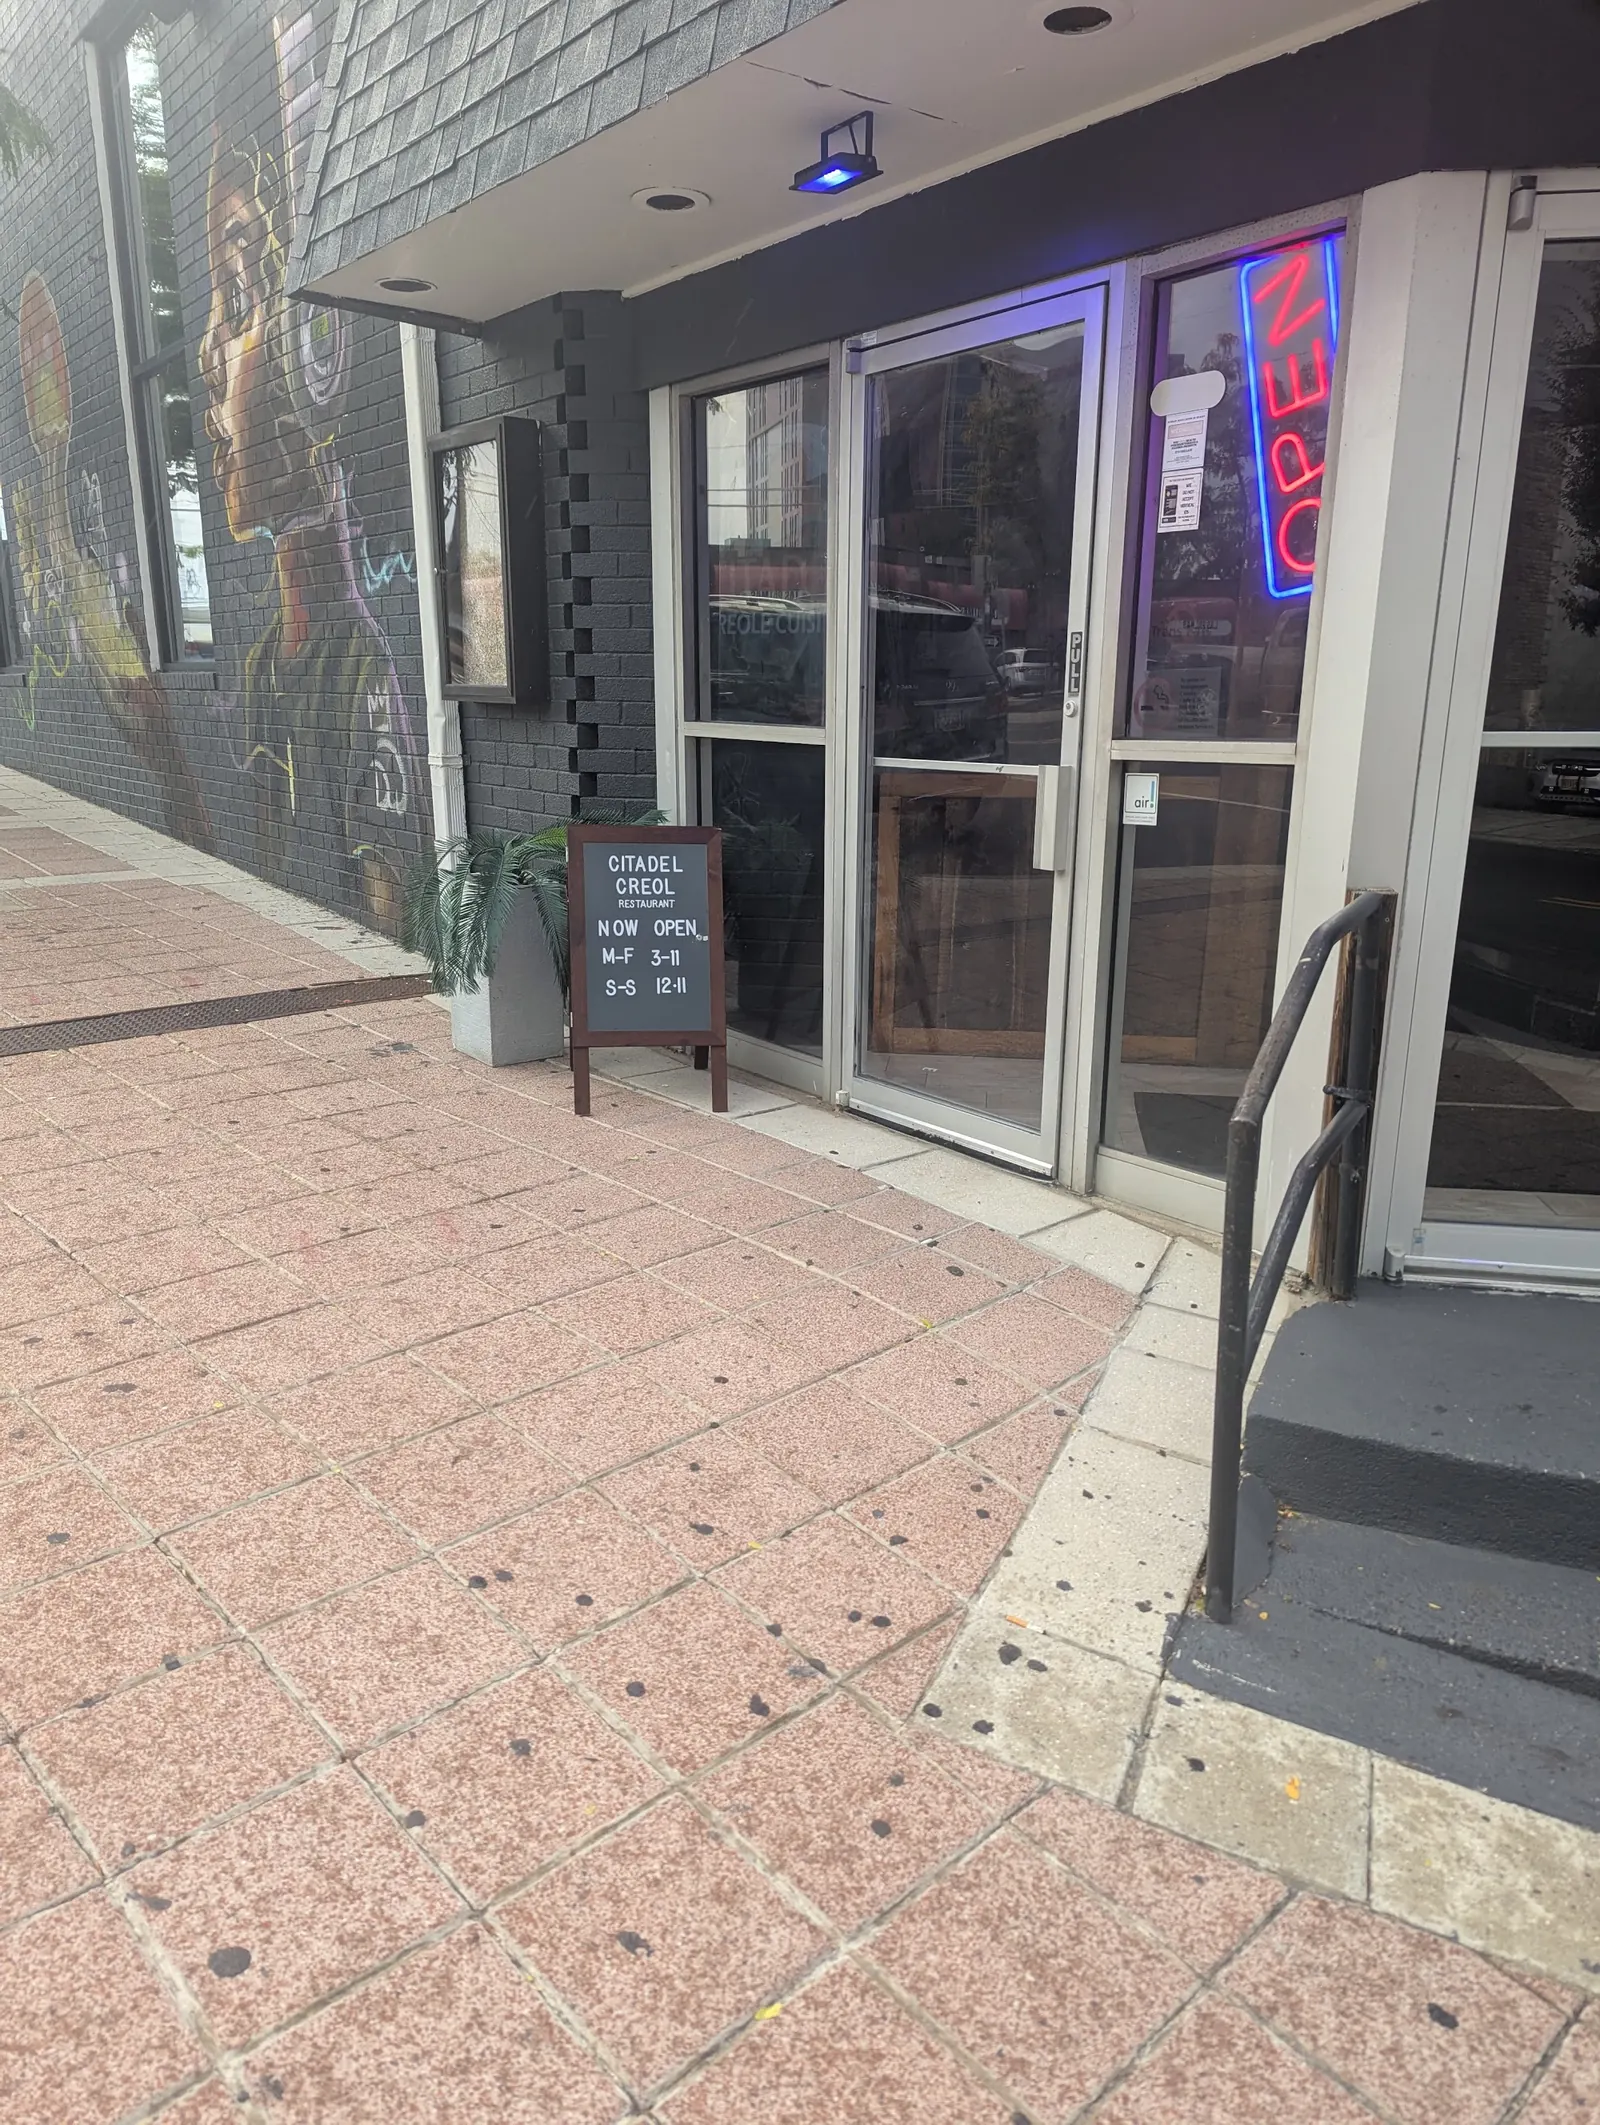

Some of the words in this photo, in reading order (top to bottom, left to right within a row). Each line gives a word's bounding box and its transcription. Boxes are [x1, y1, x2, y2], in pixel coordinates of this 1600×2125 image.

[1252, 252, 1328, 573] OPEN
[1070, 633, 1082, 692] PULL
[608, 855, 684, 872] CITADEL
[615, 878, 676, 895] CREOL
[618, 899, 675, 909] RESTAURANT
[598, 919, 638, 937] NOW
[654, 919, 697, 936] OPEN
[602, 948, 634, 965] M-F
[651, 949, 680, 966] 3-11
[605, 979, 637, 996] S-S
